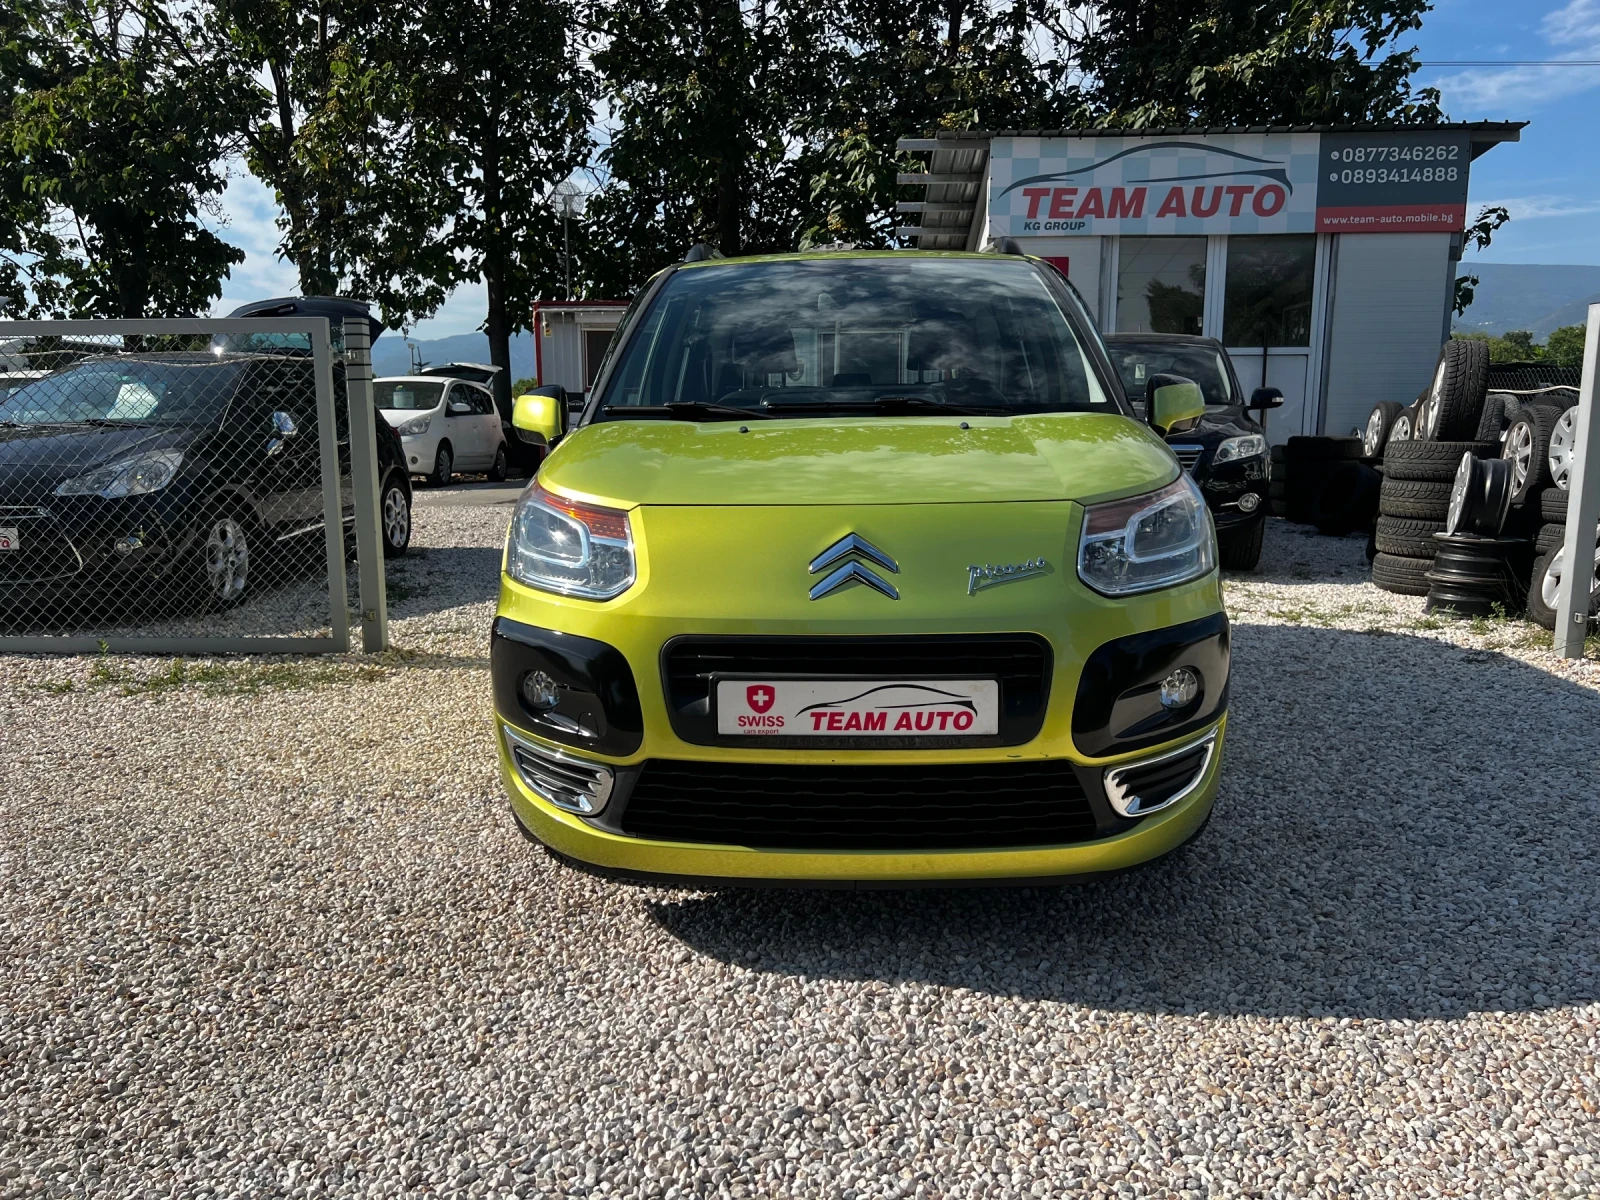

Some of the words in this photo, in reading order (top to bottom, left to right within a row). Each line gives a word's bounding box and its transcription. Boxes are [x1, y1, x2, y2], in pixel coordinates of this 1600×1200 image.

[1342, 146, 1458, 162] 0877346262
[1341, 167, 1457, 183] 0893414888
[1022, 187, 1147, 219] TEAM
[1155, 184, 1286, 218] AUTO
[1023, 221, 1041, 231] KG
[1043, 221, 1086, 231] GROUP
[1323, 213, 1453, 224] www.team-auto.mobile.bg
[738, 716, 784, 727] SWISS
[810, 711, 887, 731] TEAM
[893, 710, 974, 731] AUTO
